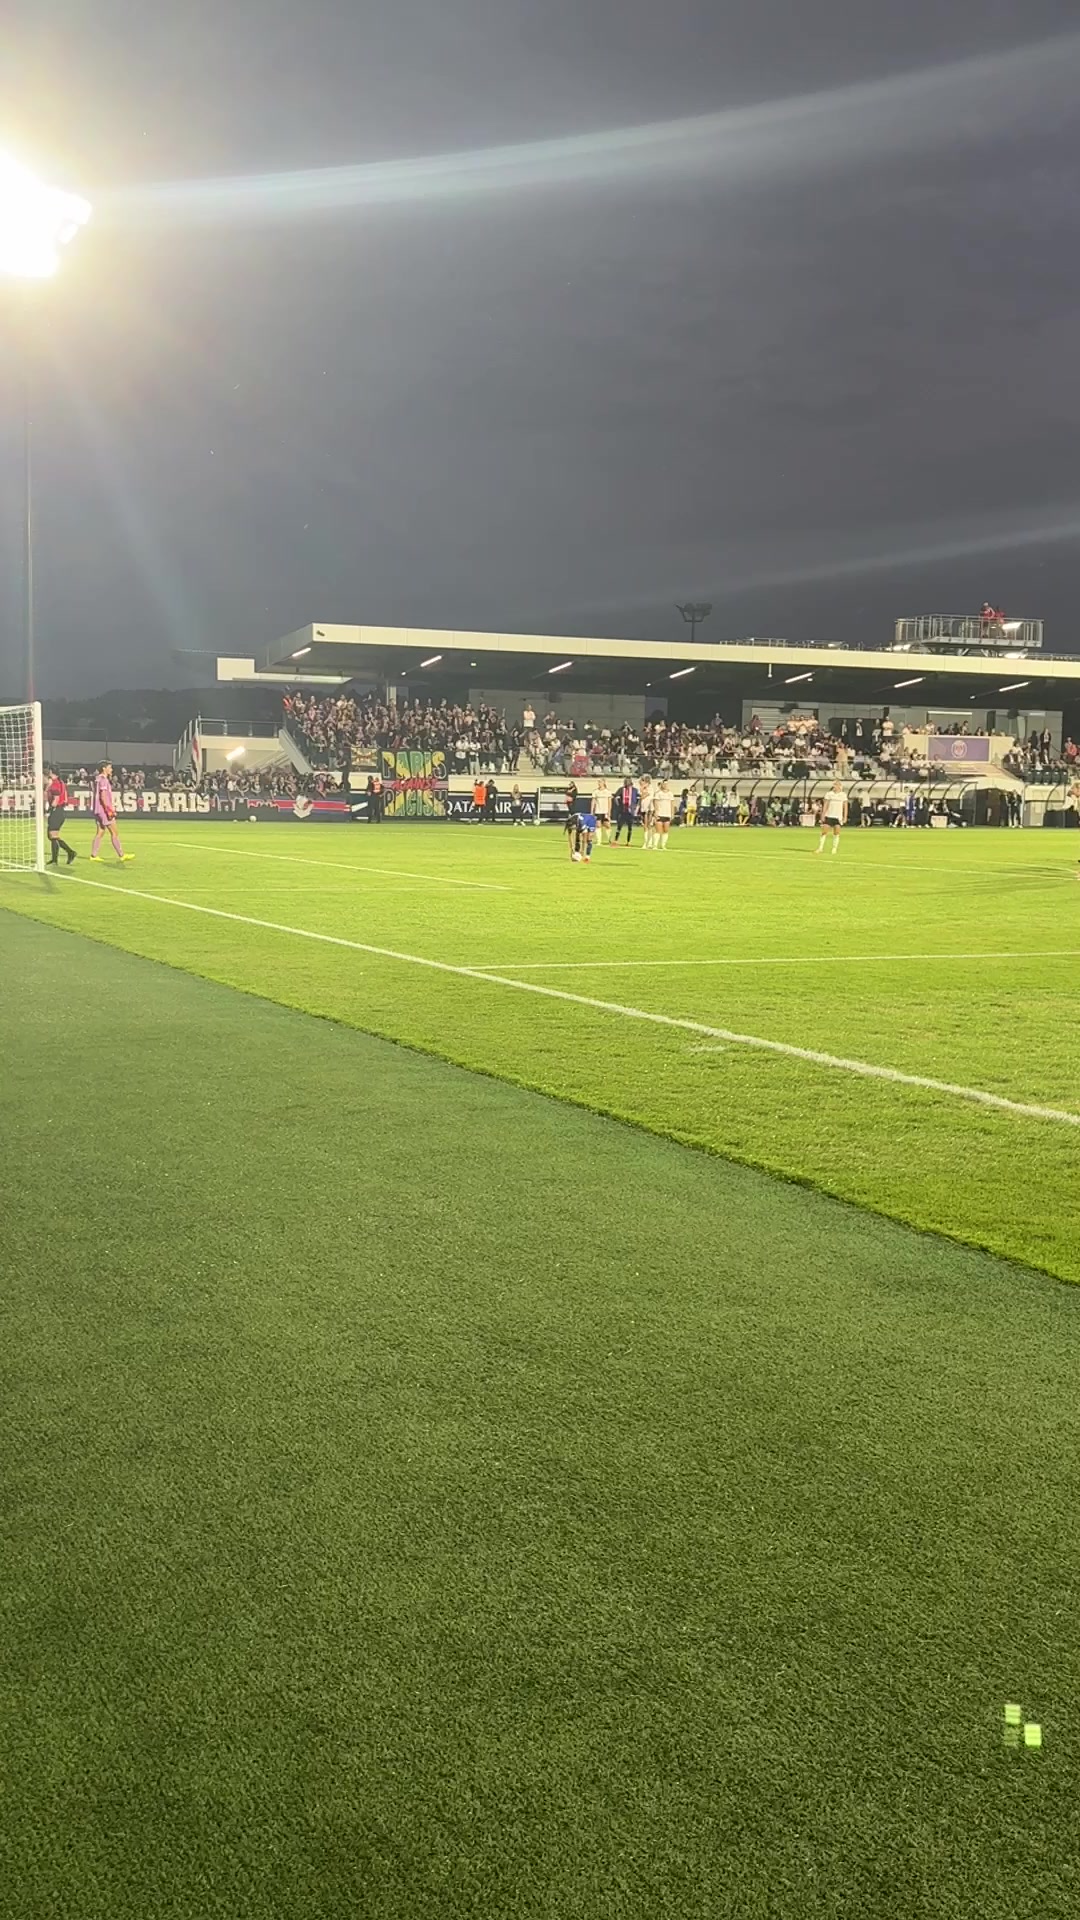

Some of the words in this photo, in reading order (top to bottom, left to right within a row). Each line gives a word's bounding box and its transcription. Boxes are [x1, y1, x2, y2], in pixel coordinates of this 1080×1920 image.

[381, 750, 447, 779] PARIS
[391, 778, 438, 793] AGAINST
[142, 791, 210, 812] PARIS
[384, 788, 447, 816] RACISM
[447, 800, 484, 815] QATA
